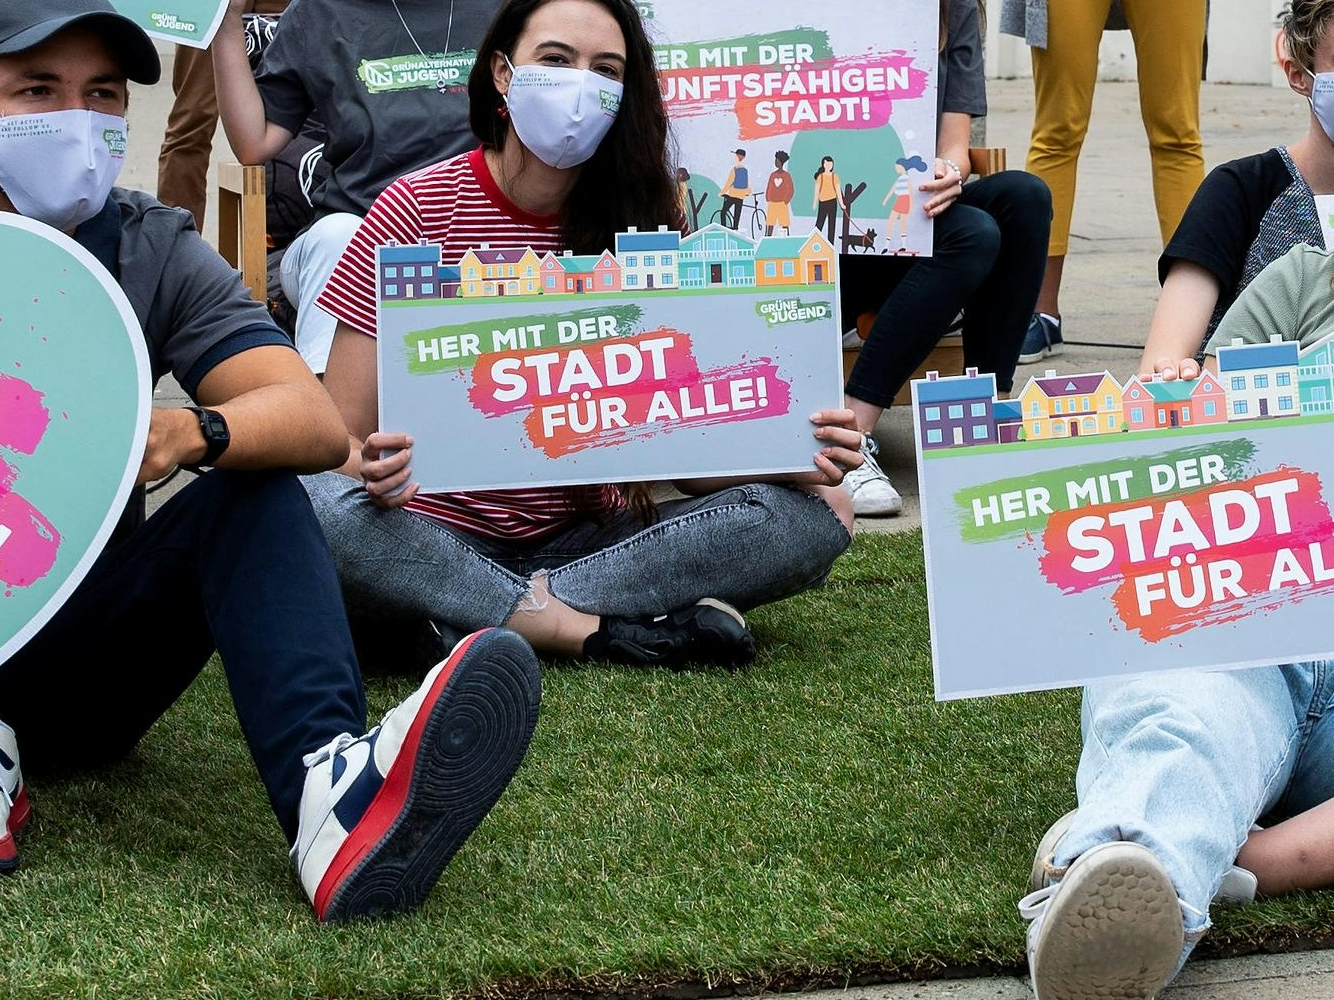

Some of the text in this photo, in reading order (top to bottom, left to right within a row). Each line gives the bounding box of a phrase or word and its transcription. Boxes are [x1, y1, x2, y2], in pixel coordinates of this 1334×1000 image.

[156, 19, 195, 31] JUGEND
[397, 67, 460, 83] JUGEND
[656, 43, 814, 70] ER MIT DER
[755, 97, 870, 126] STADT!
[760, 300, 798, 314] GRÜNE
[769, 305, 826, 324] JUGEND
[417, 315, 619, 363] HER MIT DER
[490, 337, 674, 402] STADT
[541, 375, 769, 438] FÜR ALLE!
[971, 454, 1228, 528] HER MIT DER
[1066, 478, 1300, 573] STADT
[1134, 552, 1248, 617] FÜR
